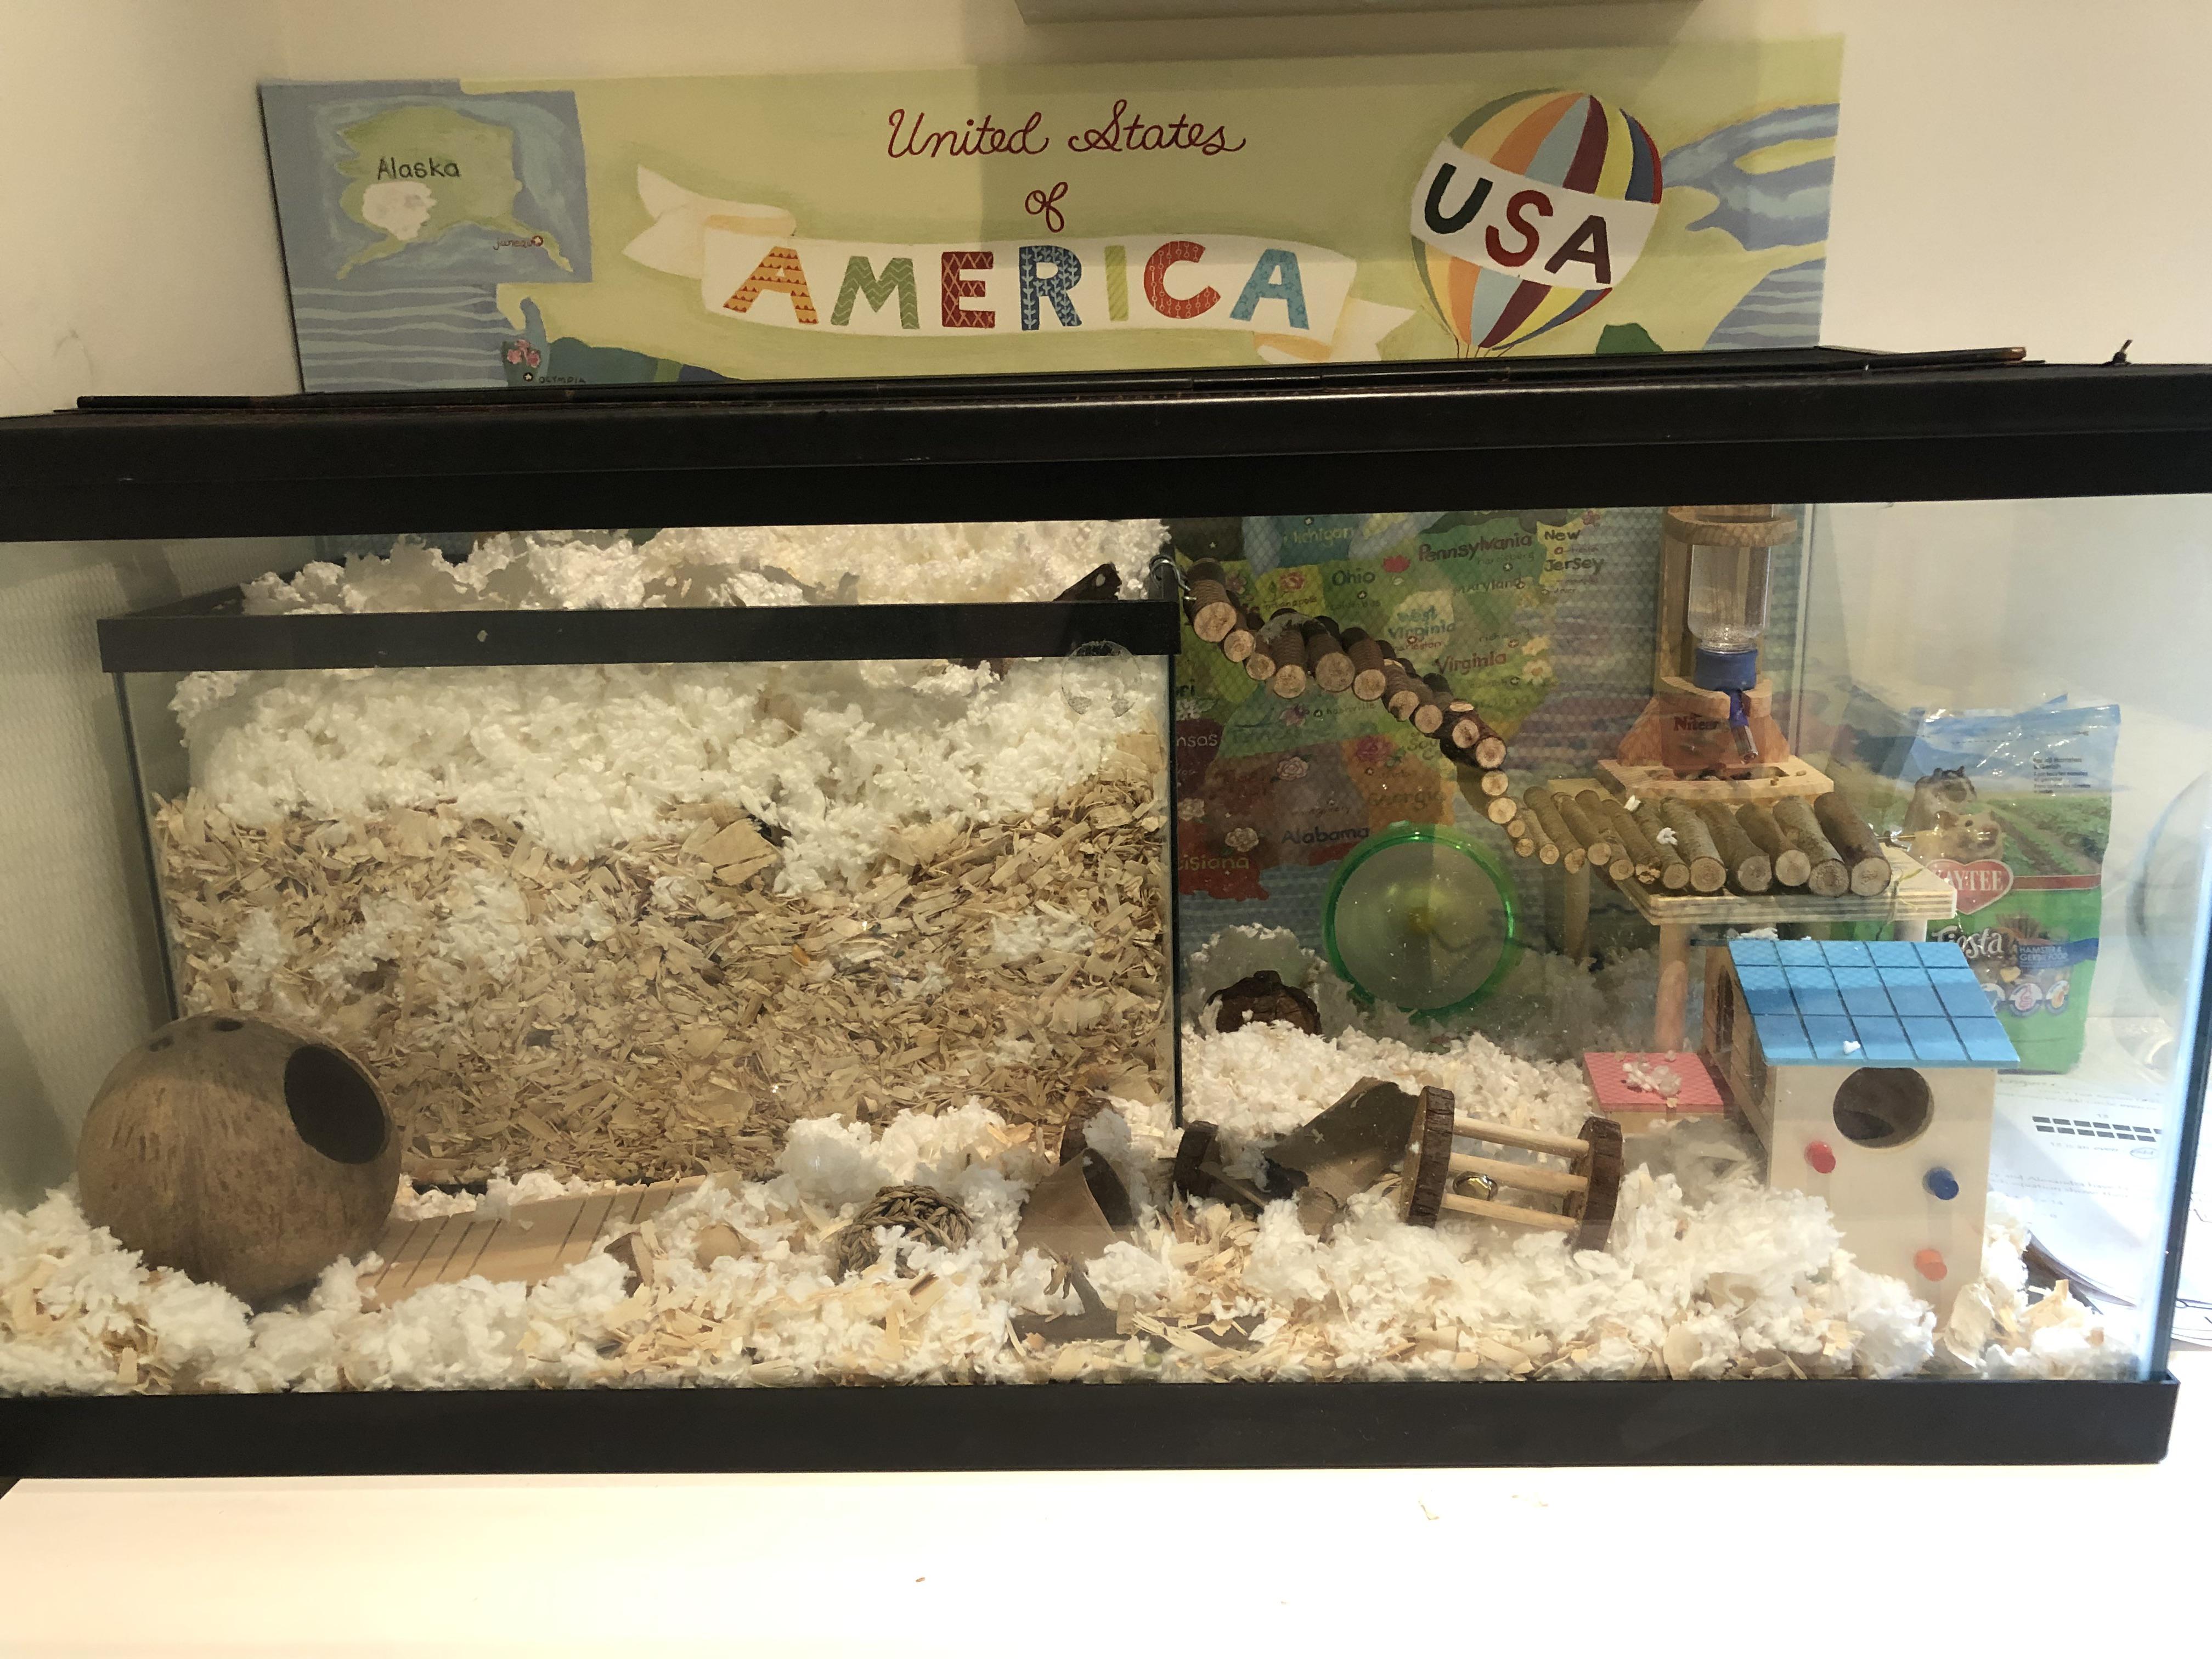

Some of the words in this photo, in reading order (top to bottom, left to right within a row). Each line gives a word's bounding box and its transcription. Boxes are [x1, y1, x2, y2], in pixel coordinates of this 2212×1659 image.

[886, 108, 1049, 159] United
[1067, 99, 1246, 155] States
[377, 157, 461, 180] Alaska
[1024, 181, 1069, 233] of
[1424, 162, 1613, 285] USA
[722, 239, 1310, 330] AMERICA
[539, 376, 586, 384] OLYMPIA
[1544, 529, 1582, 541] New
[1418, 533, 1532, 562] Pennsylvania
[1331, 567, 1376, 586] Ohio
[1544, 557, 1605, 575] Jersey
[1433, 651, 1507, 675] Virginia
[1281, 827, 1370, 844] Alabama
[1178, 854, 1250, 871] isiana
